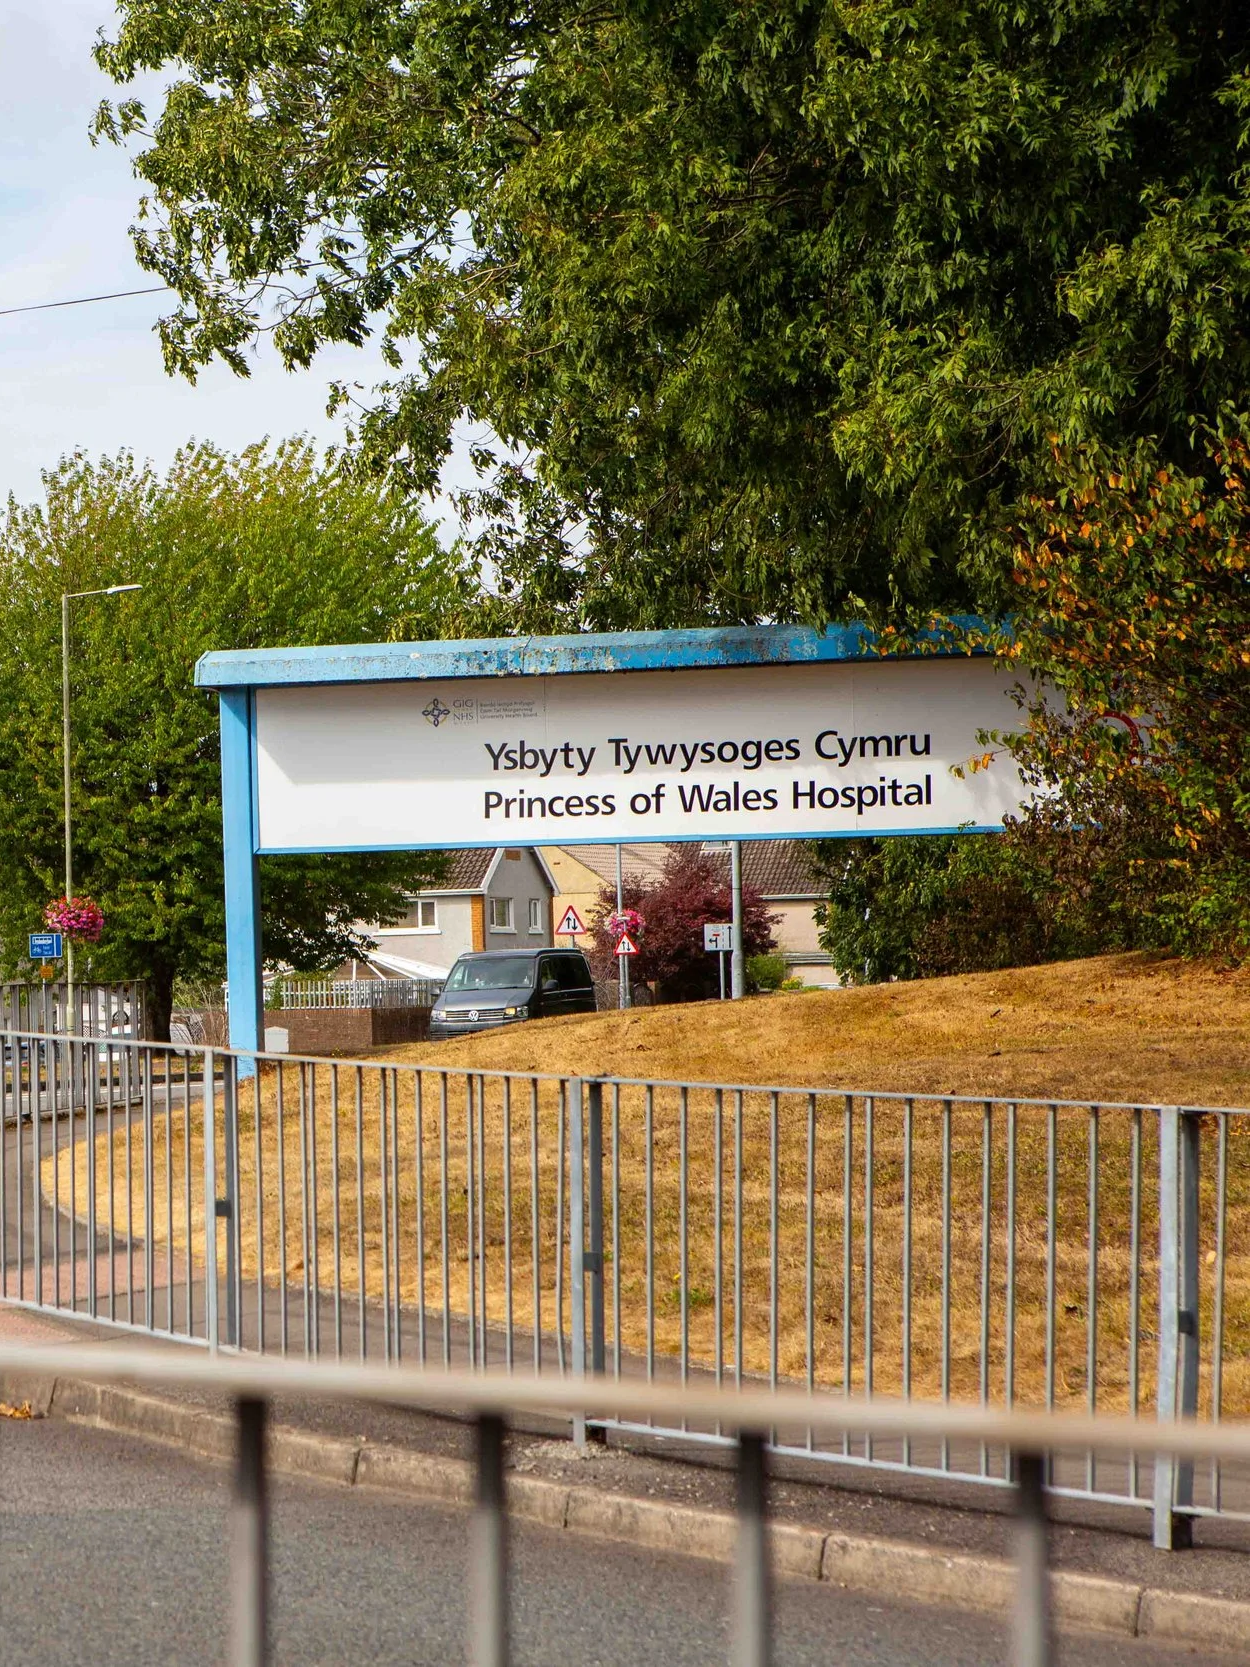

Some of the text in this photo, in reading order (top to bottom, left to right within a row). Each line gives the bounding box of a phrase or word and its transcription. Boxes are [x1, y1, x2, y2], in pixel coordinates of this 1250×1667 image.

[452, 699, 474, 708] GIG
[453, 712, 474, 721] NHS
[484, 730, 931, 777] Ysbyty Tywysoges Cymru
[484, 774, 932, 819] Princess of Wales Hospital
